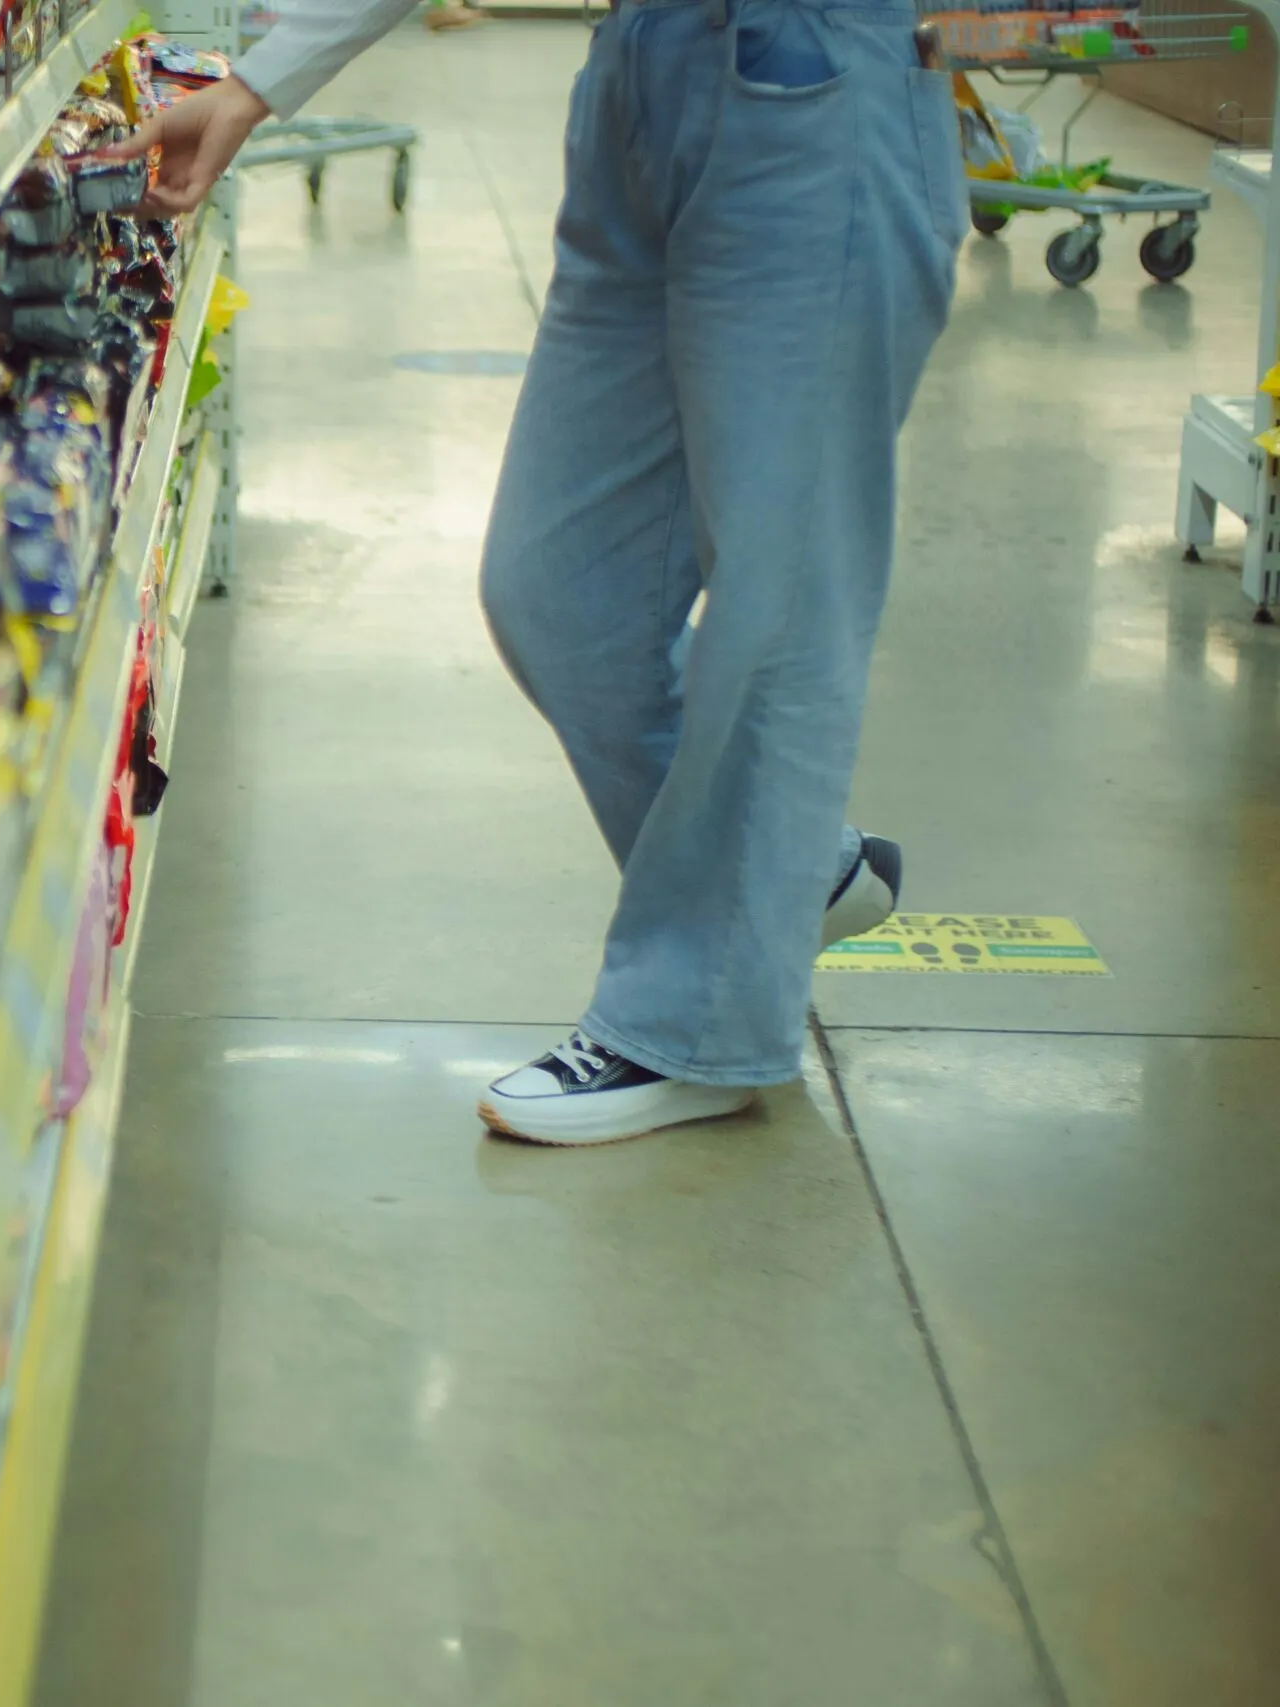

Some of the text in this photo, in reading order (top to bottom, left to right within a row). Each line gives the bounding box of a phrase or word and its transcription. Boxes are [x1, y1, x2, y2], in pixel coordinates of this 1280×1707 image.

[885, 915, 1043, 930] EASE
[877, 927, 1056, 940] AIT HERE
